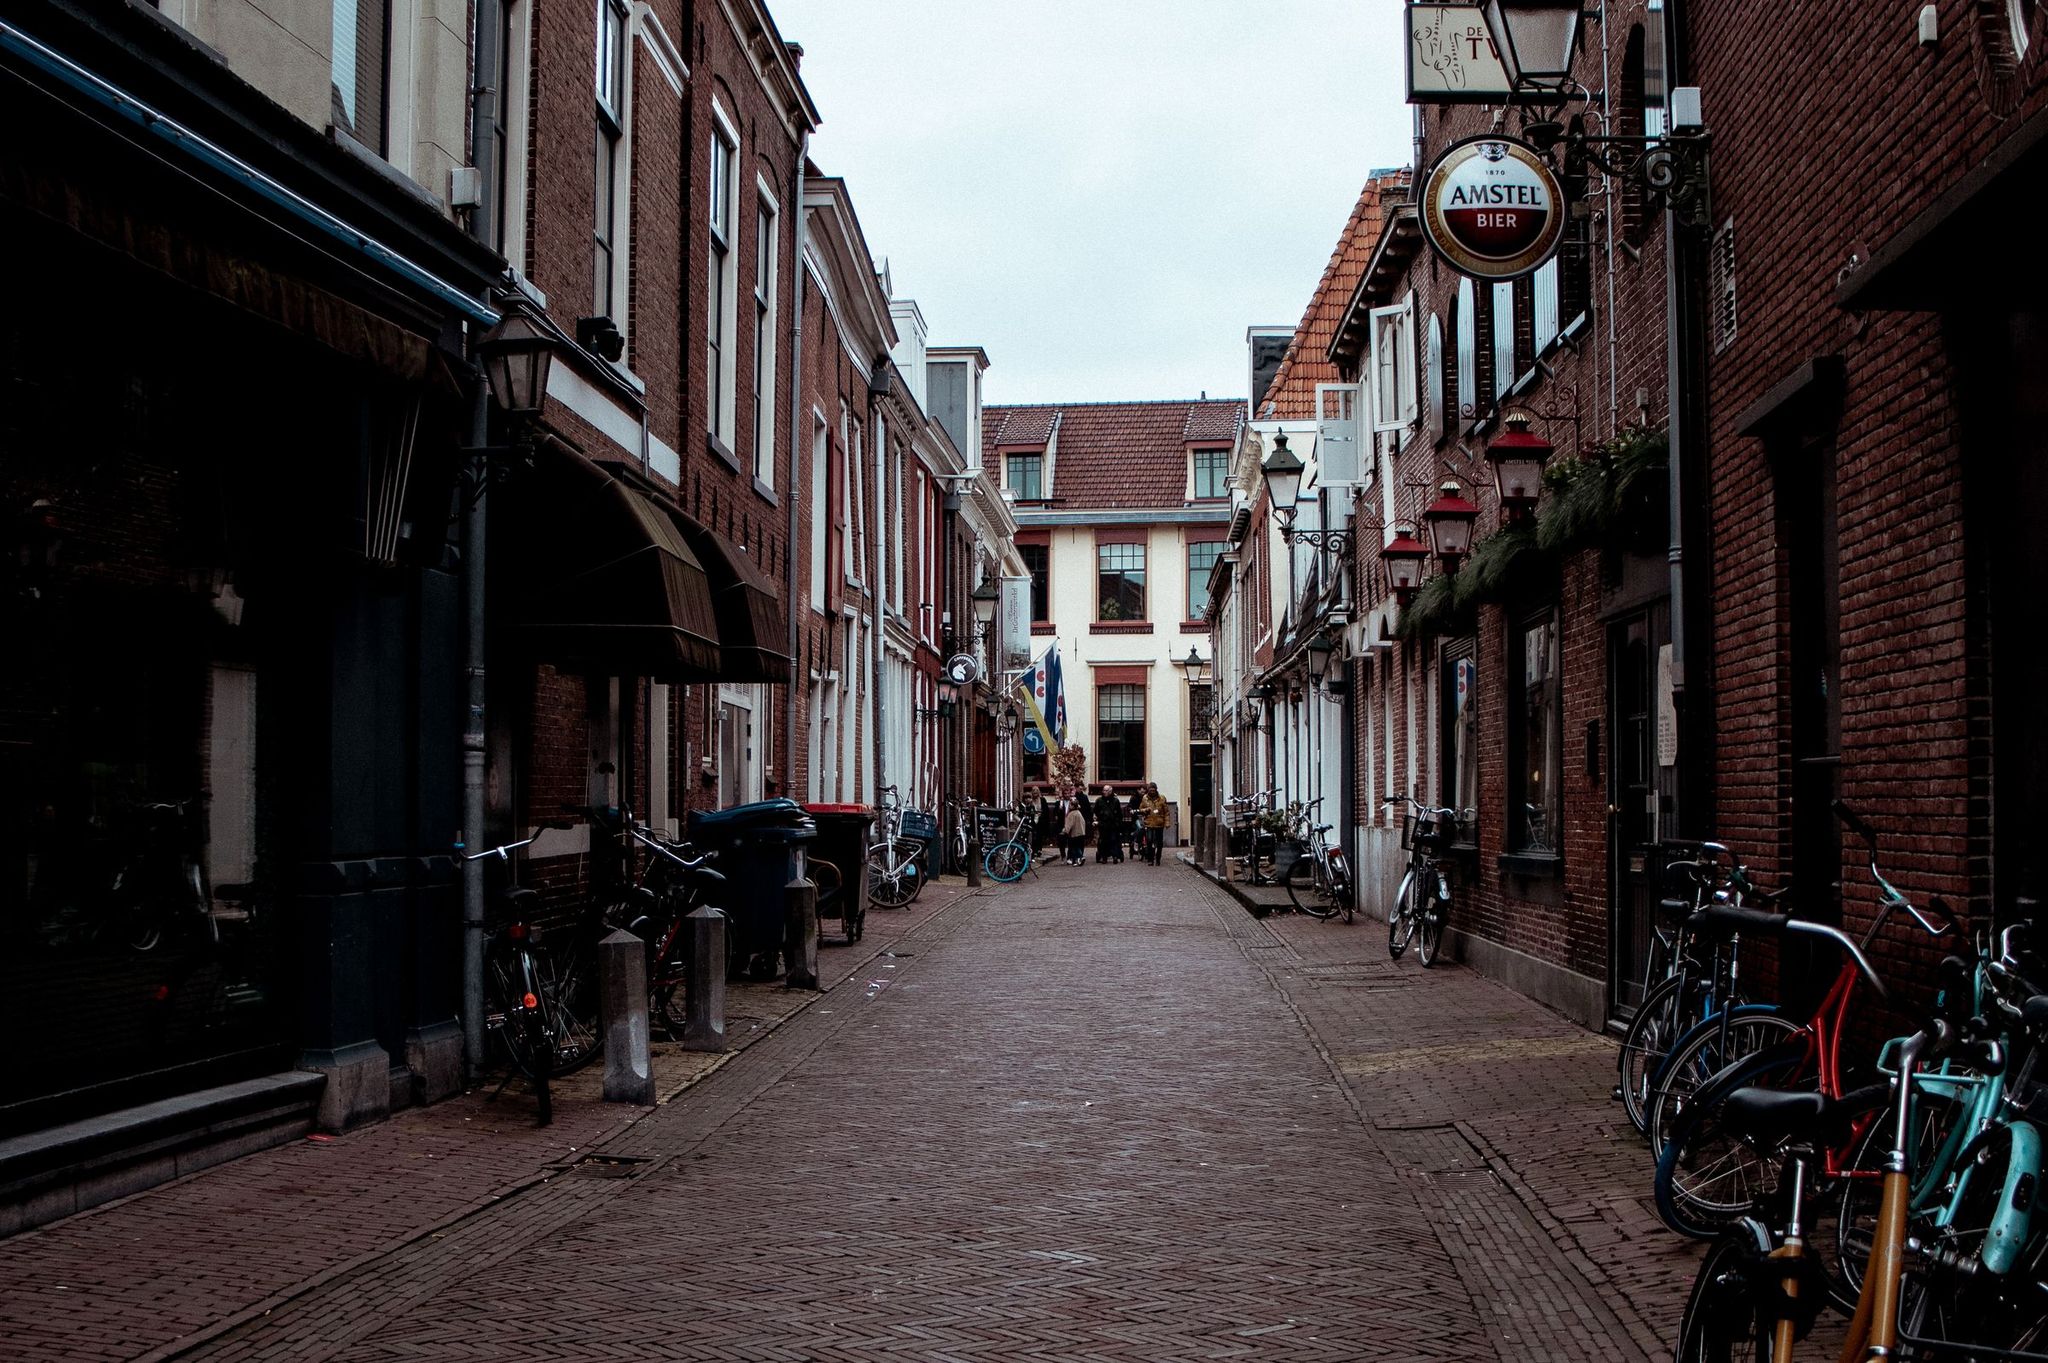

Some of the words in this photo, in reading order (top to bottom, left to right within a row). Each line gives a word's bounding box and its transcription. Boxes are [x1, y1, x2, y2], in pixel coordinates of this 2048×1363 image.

[1467, 27, 1483, 36] DE
[1450, 184, 1542, 206] AMSTEL
[1427, 190, 1442, 237] VOLGENS
[1477, 213, 1517, 228] BIER
